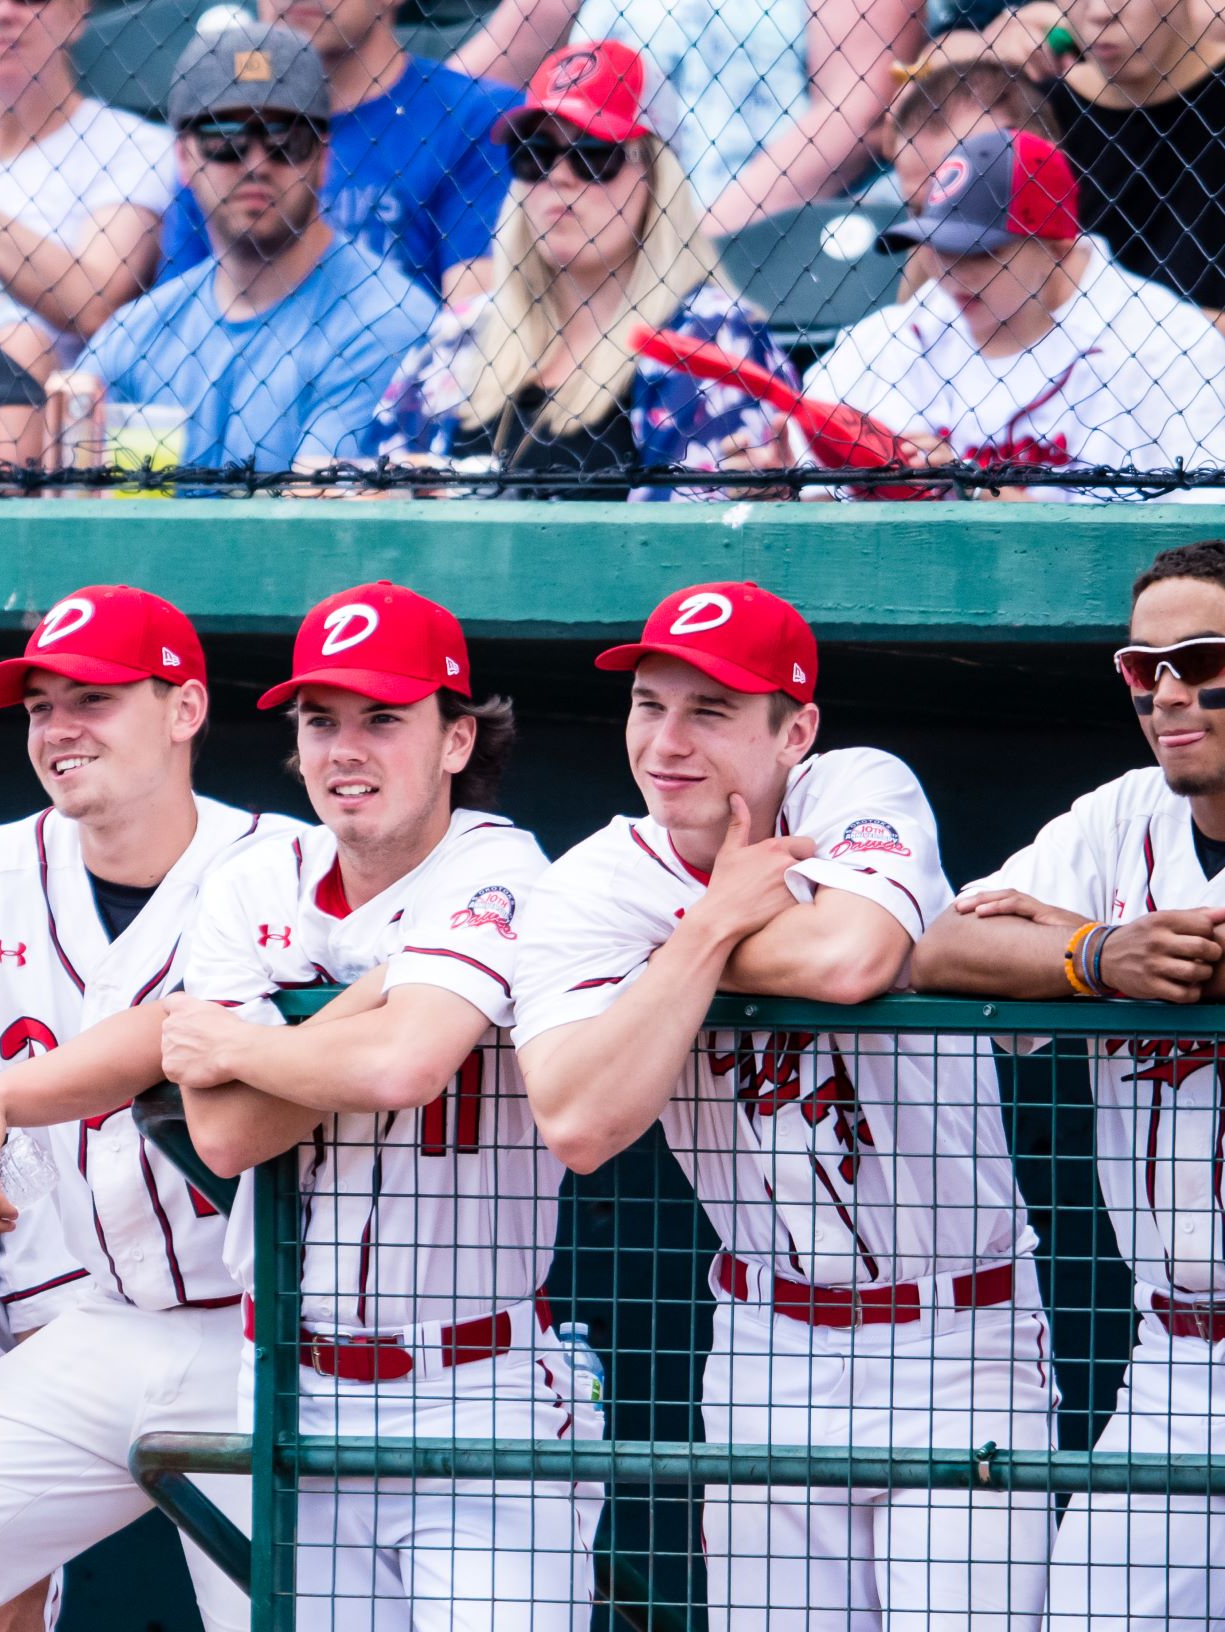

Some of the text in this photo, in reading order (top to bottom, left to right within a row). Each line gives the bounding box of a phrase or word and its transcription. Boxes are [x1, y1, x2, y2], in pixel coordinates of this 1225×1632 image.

[38, 598, 94, 648] D
[322, 603, 379, 656] D
[670, 592, 733, 635] D
